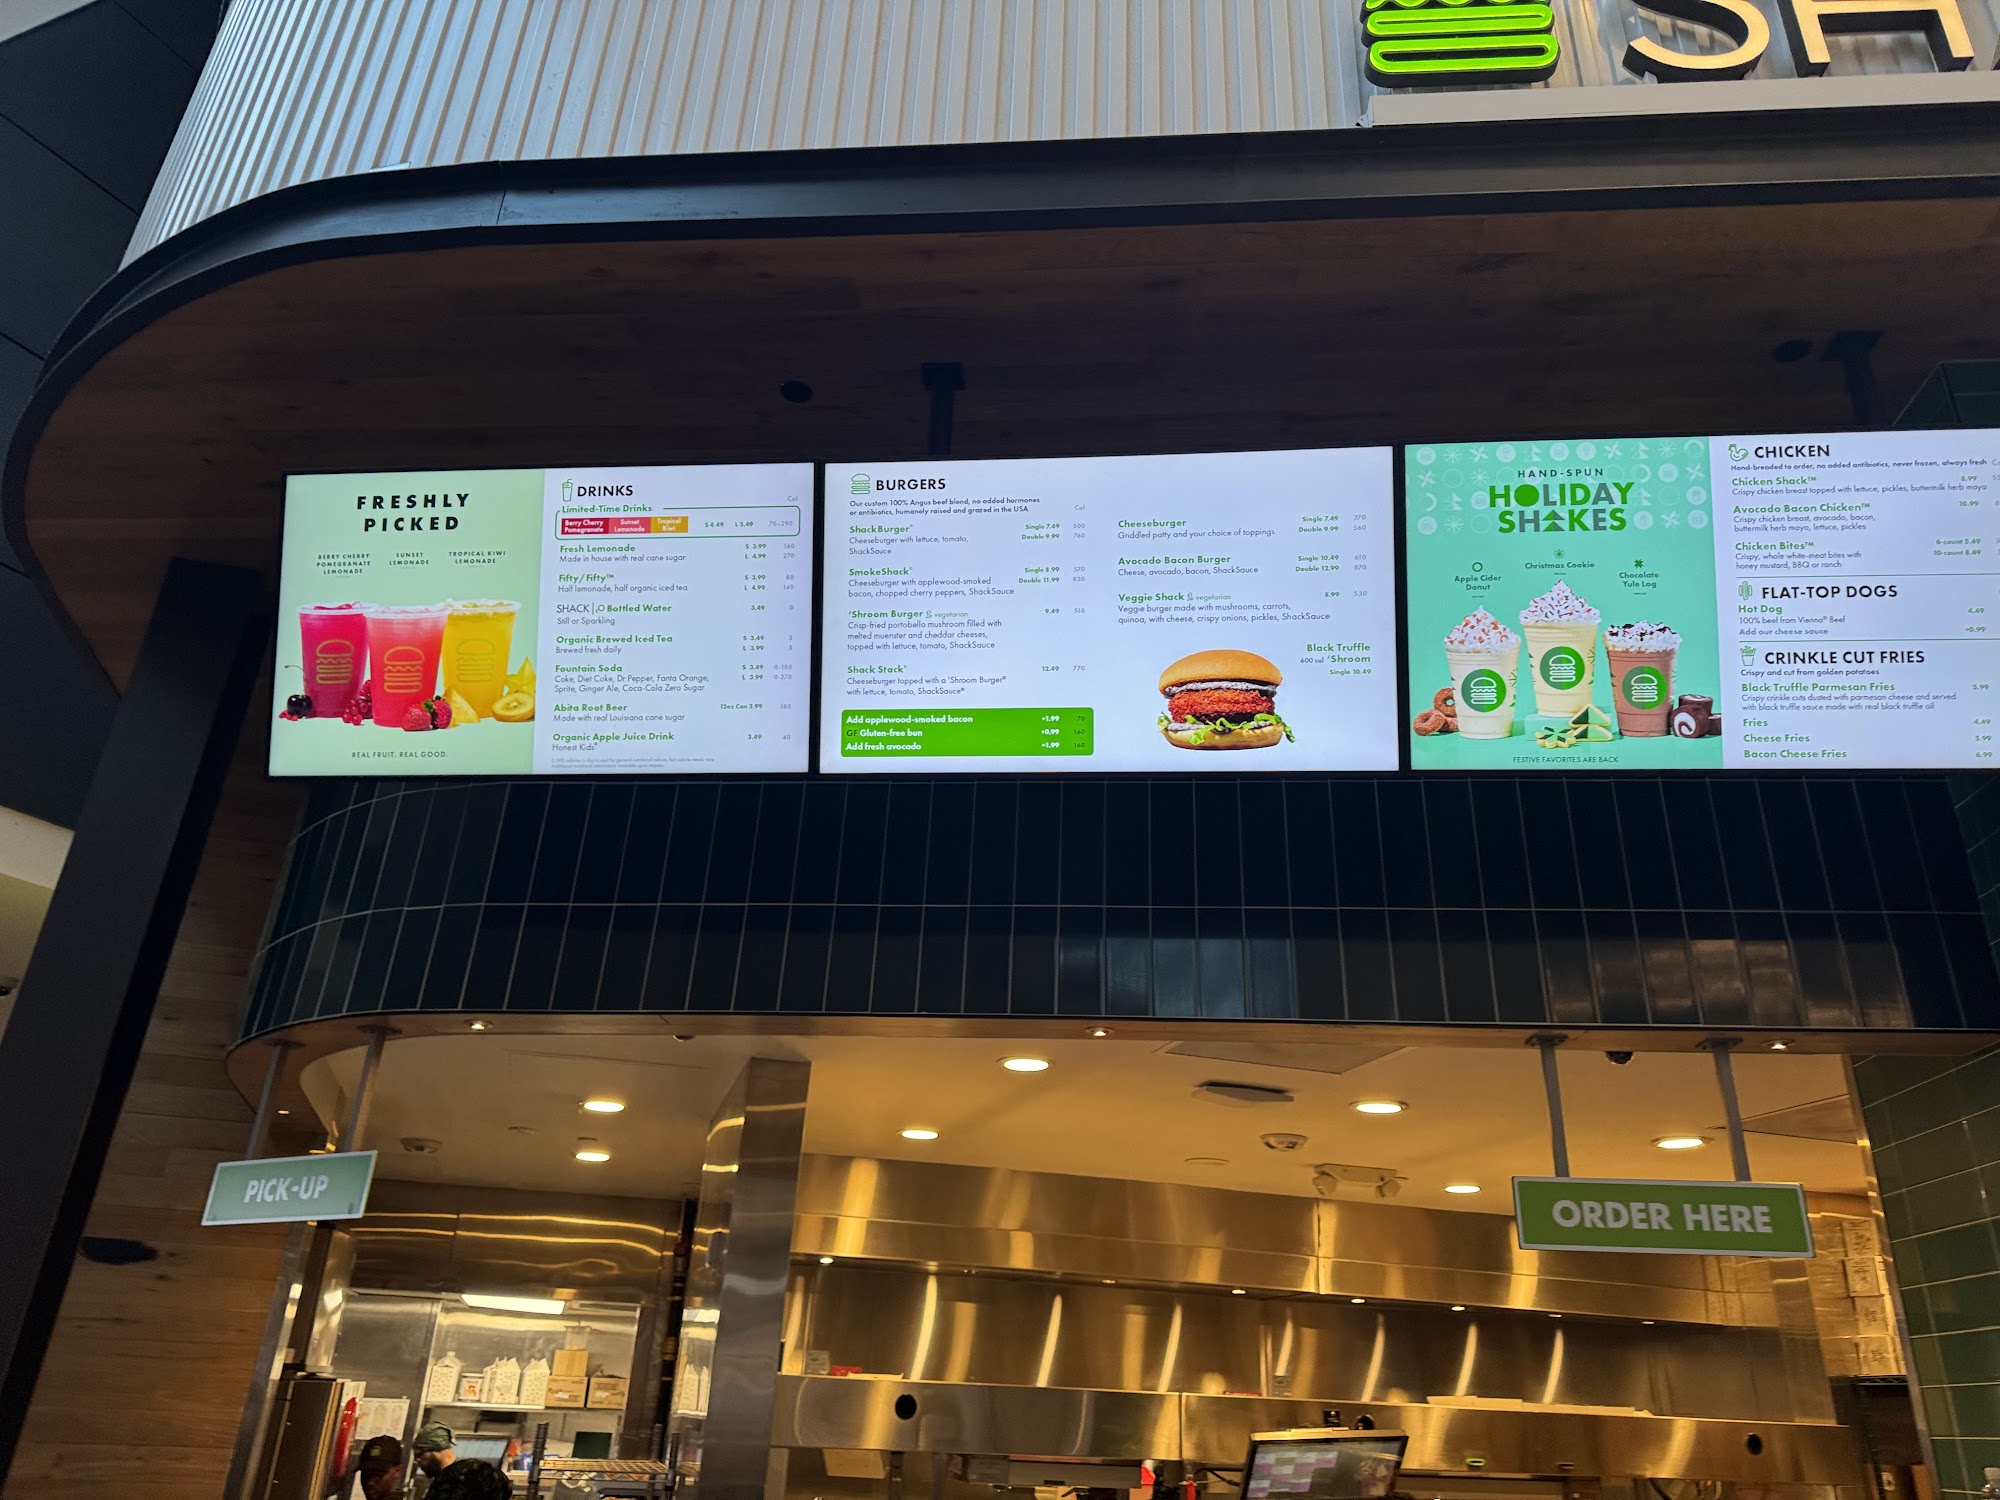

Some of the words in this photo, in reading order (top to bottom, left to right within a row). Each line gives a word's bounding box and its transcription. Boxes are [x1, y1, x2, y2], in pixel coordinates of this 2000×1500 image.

[1754, 444, 1830, 459] CHICKEN
[1517, 468, 1603, 479] HAND-SPUN
[876, 478, 946, 491] BURGERS
[1731, 477, 1773, 486] Chicken
[577, 485, 633, 497] DRINKS
[1489, 481, 1635, 508] HOLIDAY
[357, 493, 469, 510] FRESHLY
[562, 504, 620, 514] Limited-Time
[622, 504, 652, 512] Drinks
[1733, 504, 1781, 514] Avocado
[1784, 504, 1817, 513] Bacon
[364, 516, 458, 532] PICKED
[564, 520, 582, 529] Berry
[583, 519, 604, 528] Cherry
[620, 519, 642, 527] Sunset
[657, 517, 681, 526] Tropical
[1118, 519, 1187, 529] Cheeseburger
[1498, 507, 1627, 534] SHAKES
[564, 527, 604, 535] Pomegranate
[613, 525, 645, 533] Lemonade
[1025, 523, 1045, 531] Single
[1117, 530, 1151, 539] Griddled
[1152, 531, 1171, 540] patty
[1172, 529, 1187, 538] and
[1189, 531, 1206, 540] your
[1207, 529, 1232, 537] choice
[1233, 527, 1241, 536] of
[1243, 528, 1275, 538] toppings
[560, 544, 584, 553] Fresh
[587, 543, 636, 552] Lemonade
[849, 547, 892, 555] ShackSauce
[1735, 541, 1776, 551] Chicken
[559, 554, 581, 563] Made
[591, 554, 612, 562] house
[614, 553, 629, 562] with
[630, 553, 644, 562] real
[665, 555, 686, 563] sugar
[1118, 556, 1161, 565] Avocado
[1164, 556, 1194, 564] Bacon
[1197, 555, 1231, 565] Burger
[1298, 555, 1318, 563] Single
[1524, 562, 1565, 570] Christmas
[1566, 561, 1595, 569] Cookie
[1117, 568, 1147, 577] Cheese,
[1148, 567, 1183, 576] avocado,
[1185, 566, 1210, 575] bacon,
[1213, 565, 1259, 574] ShackSauce
[1618, 571, 1659, 579] Chocolate
[1454, 575, 1478, 584] Apple
[1480, 574, 1502, 582] Cider
[1466, 583, 1491, 591] Donut
[1622, 580, 1640, 588] Yule
[1642, 580, 1657, 589] Log
[1762, 586, 1840, 599] FLAT-TOP
[1846, 585, 1898, 598] DOGS
[1118, 593, 1153, 604] Veggie
[1155, 592, 1185, 601] Shack
[607, 603, 640, 612] Bottled
[642, 604, 672, 612] Water
[1738, 605, 1757, 613] Hot
[1760, 604, 1783, 615] Dog
[891, 609, 924, 620] Burger
[556, 635, 593, 647] Organic
[596, 634, 632, 643] Brewed
[635, 634, 654, 643] Iced
[656, 634, 673, 642] Tea
[1307, 643, 1334, 652] Black
[1337, 642, 1371, 652] Truffle
[1765, 651, 1837, 664] CRINKLE
[1843, 651, 1874, 664] CUT
[1880, 650, 1925, 664] FRIES
[555, 664, 595, 673] Fountain
[598, 664, 622, 672] Soda
[847, 665, 875, 674] Shack
[1329, 668, 1350, 676] Single
[1740, 669, 1765, 678] Crispy
[1766, 668, 1782, 676] and
[1796, 668, 1815, 676] from
[1816, 668, 1844, 678] golden
[1845, 669, 1880, 677] potatoes
[1741, 682, 1771, 692] Black
[1773, 682, 1809, 692] Truffle
[1812, 683, 1866, 691] Parmesan
[1870, 682, 1895, 691] Fries
[553, 703, 579, 712] Abita
[582, 703, 603, 712] Root
[606, 703, 628, 711] Beer
[846, 715, 863, 724] Add
[865, 714, 946, 726] applewood-smoked
[948, 714, 973, 723] bacon
[1743, 718, 1768, 727] Fries
[552, 732, 590, 743] Organic
[592, 732, 620, 743] Apple
[623, 732, 646, 740] Juice
[649, 732, 674, 740] Drink
[845, 729, 860, 738] GF
[859, 728, 905, 737] Gluten-free
[907, 728, 923, 737] bun
[1743, 734, 1781, 743] Cheese
[1785, 733, 1810, 742] Fries
[845, 742, 863, 750] Add
[864, 742, 885, 750] fresh
[886, 741, 922, 750] avocado
[1744, 749, 1777, 758] Bacon
[1780, 749, 1818, 758] Cheese
[1821, 749, 1847, 758] Fries
[243, 1175, 328, 1204] PICK-UP
[1552, 1199, 1673, 1230] ORDER
[1683, 1203, 1773, 1233] HERE
